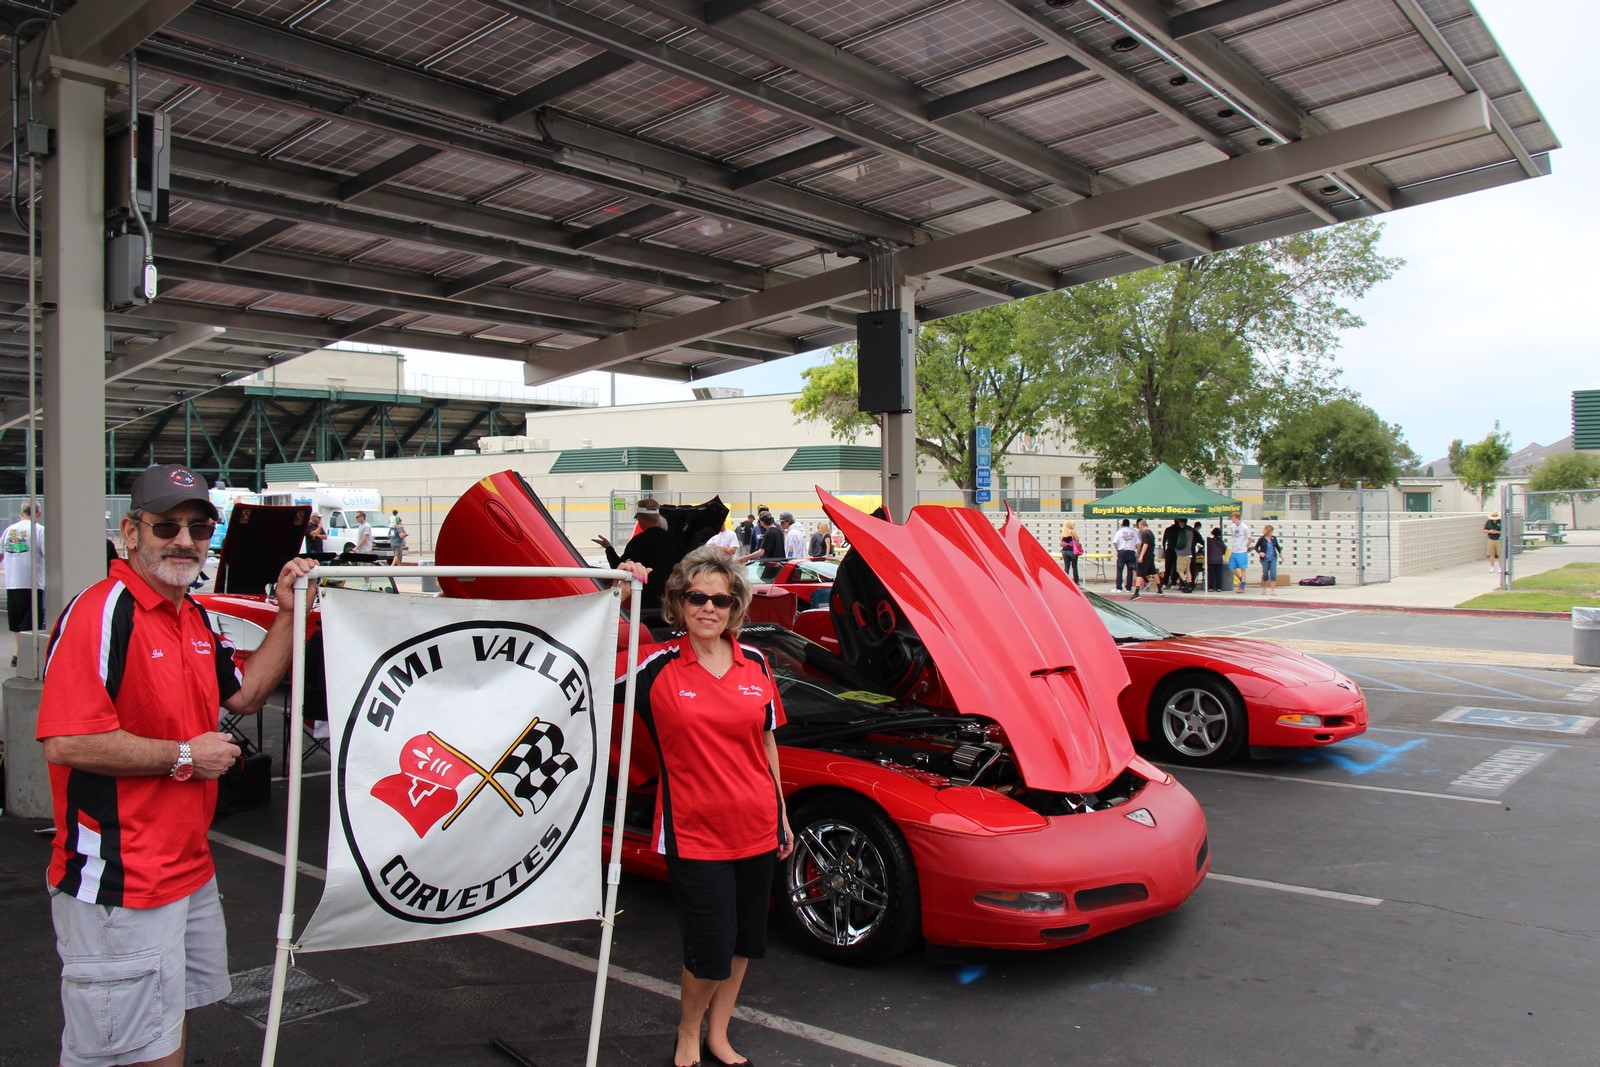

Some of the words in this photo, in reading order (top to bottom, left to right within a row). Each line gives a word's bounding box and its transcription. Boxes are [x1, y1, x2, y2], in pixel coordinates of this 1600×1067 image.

[621, 449, 629, 466] 4
[1092, 506, 1114, 515] Royal
[1116, 506, 1135, 515] High
[1137, 505, 1165, 513] School
[1166, 506, 1197, 514] Soccer
[367, 644, 443, 733] SIMI
[471, 634, 588, 718] VALLEY
[379, 823, 562, 913] CORVETTES
